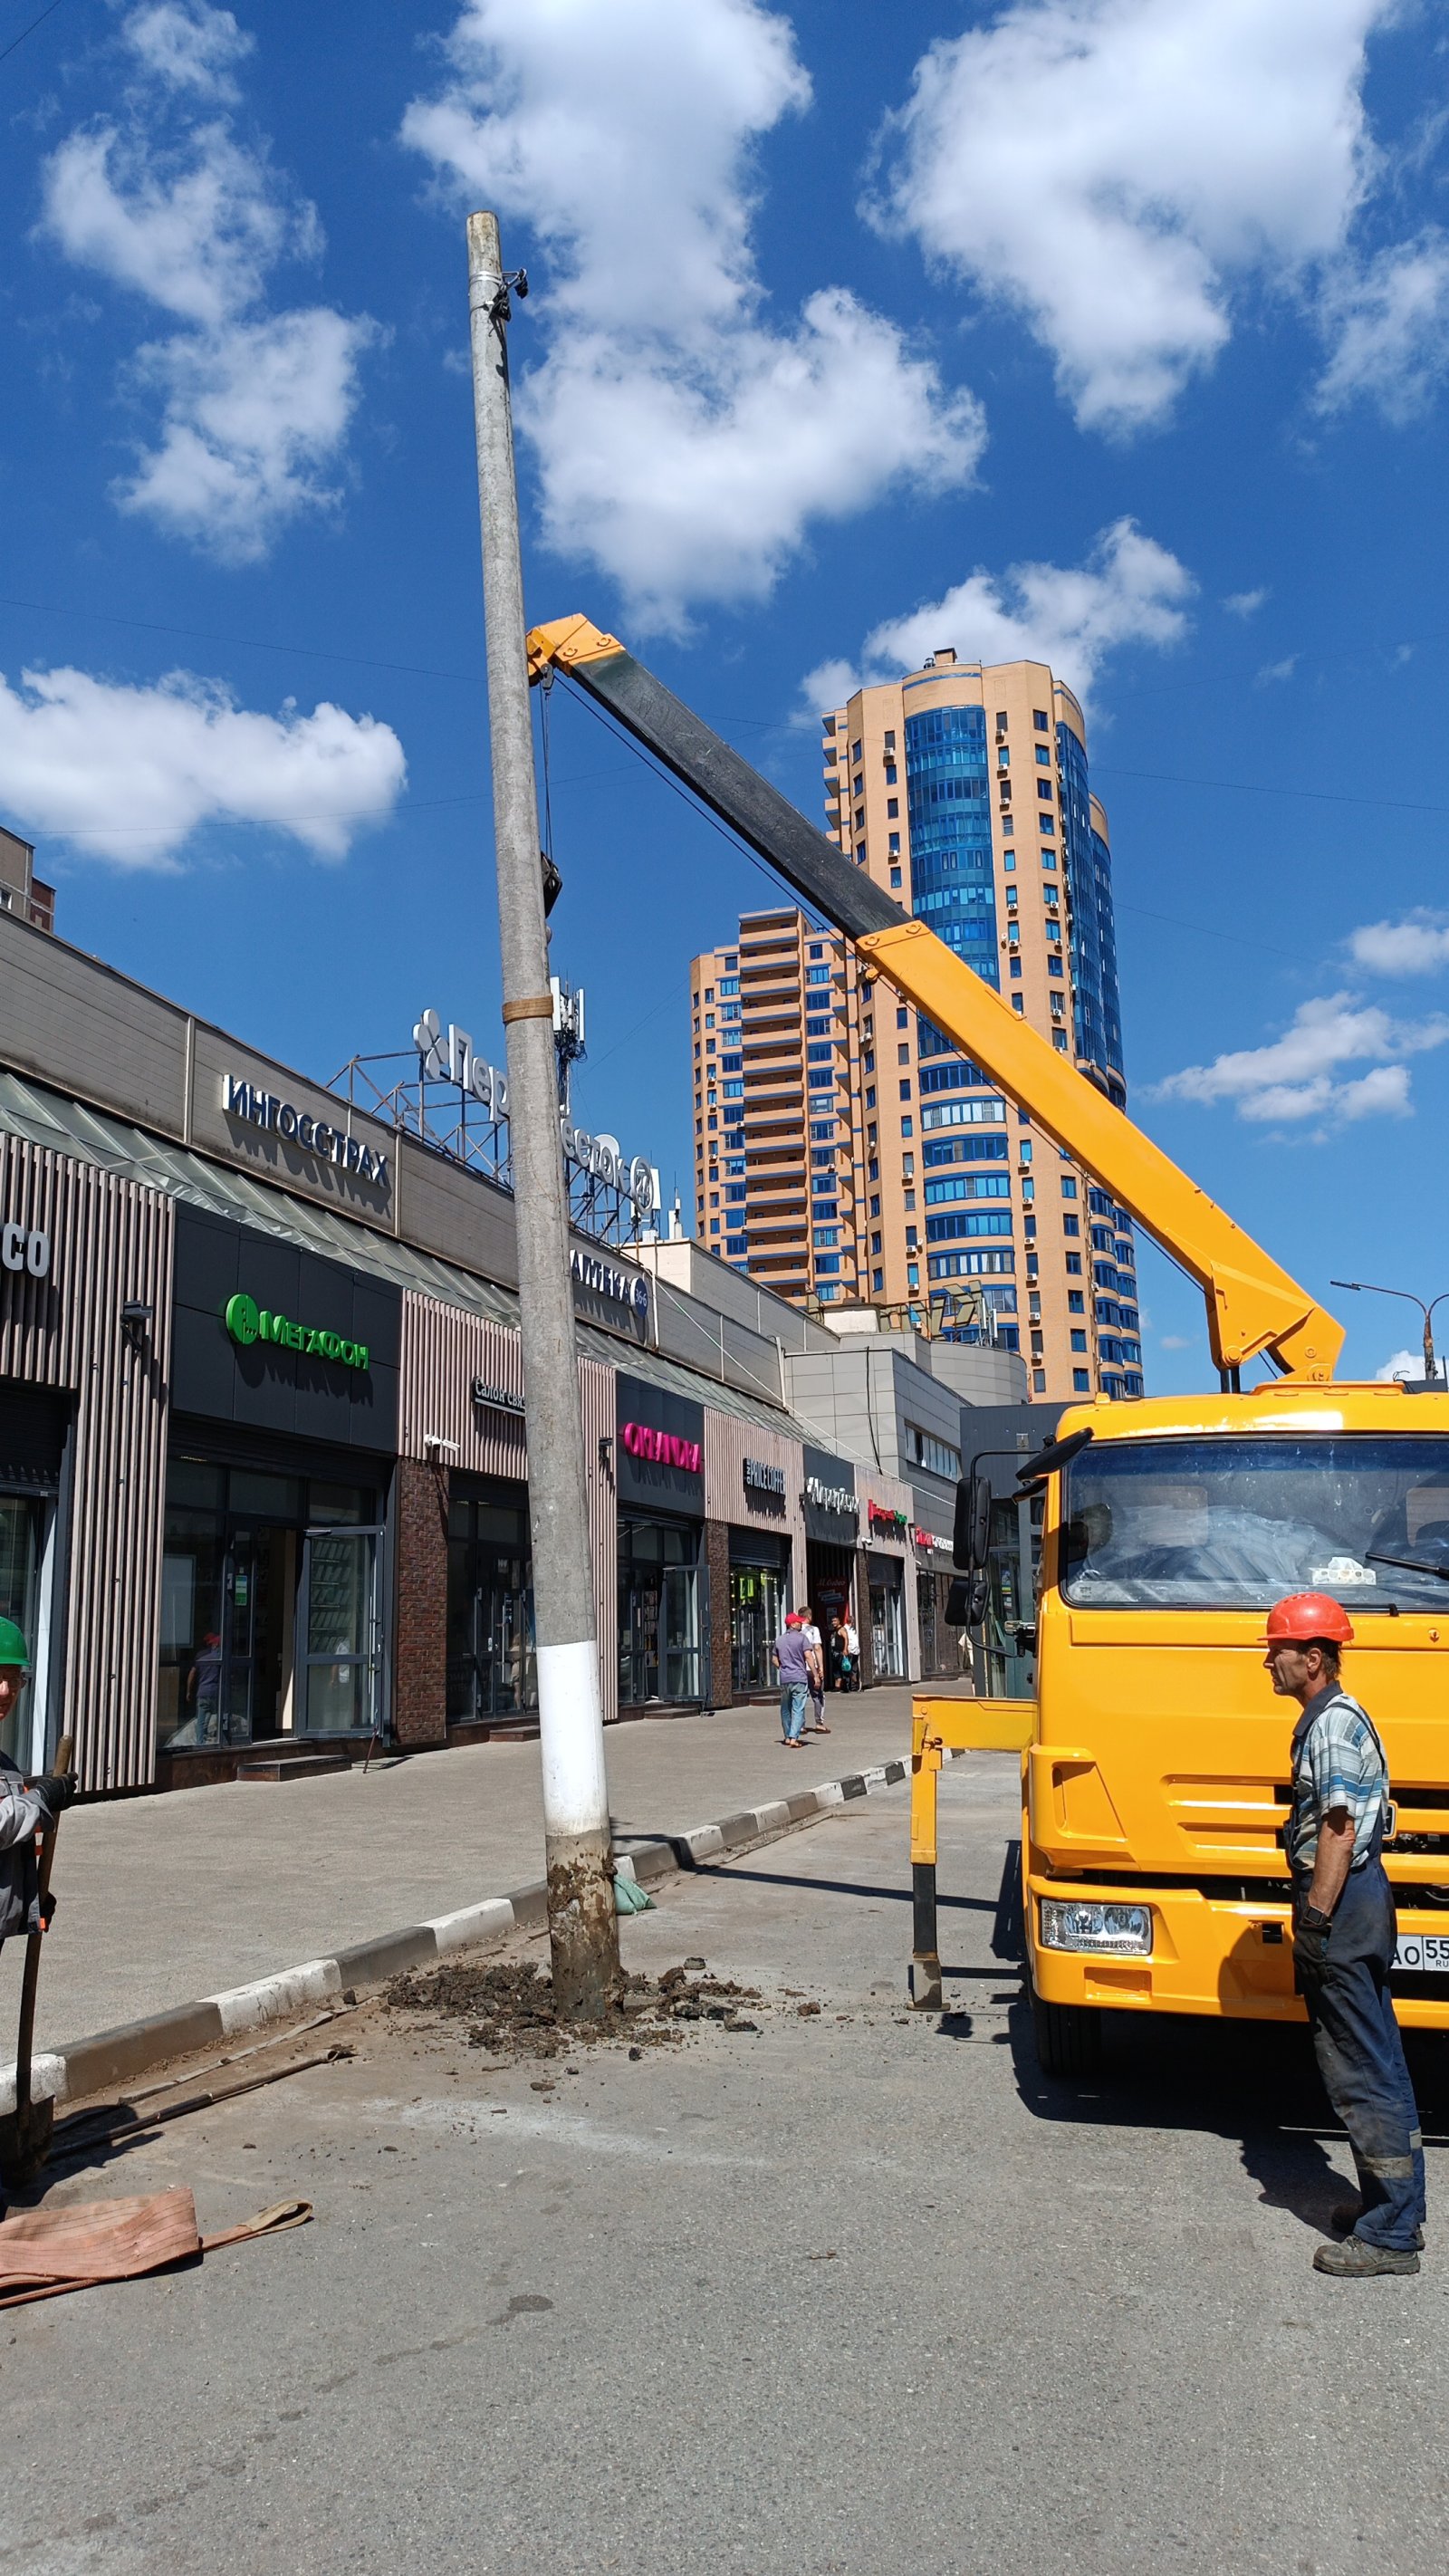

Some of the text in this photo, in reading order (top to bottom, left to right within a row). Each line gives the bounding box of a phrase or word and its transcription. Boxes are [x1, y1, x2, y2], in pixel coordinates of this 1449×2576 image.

[222, 1074, 389, 1187] ИНГОССТРАХ
[570, 1249, 631, 1307] АПТЕКА
[475, 1377, 504, 1404] Салон
[750, 1458, 767, 1488] PRICE
